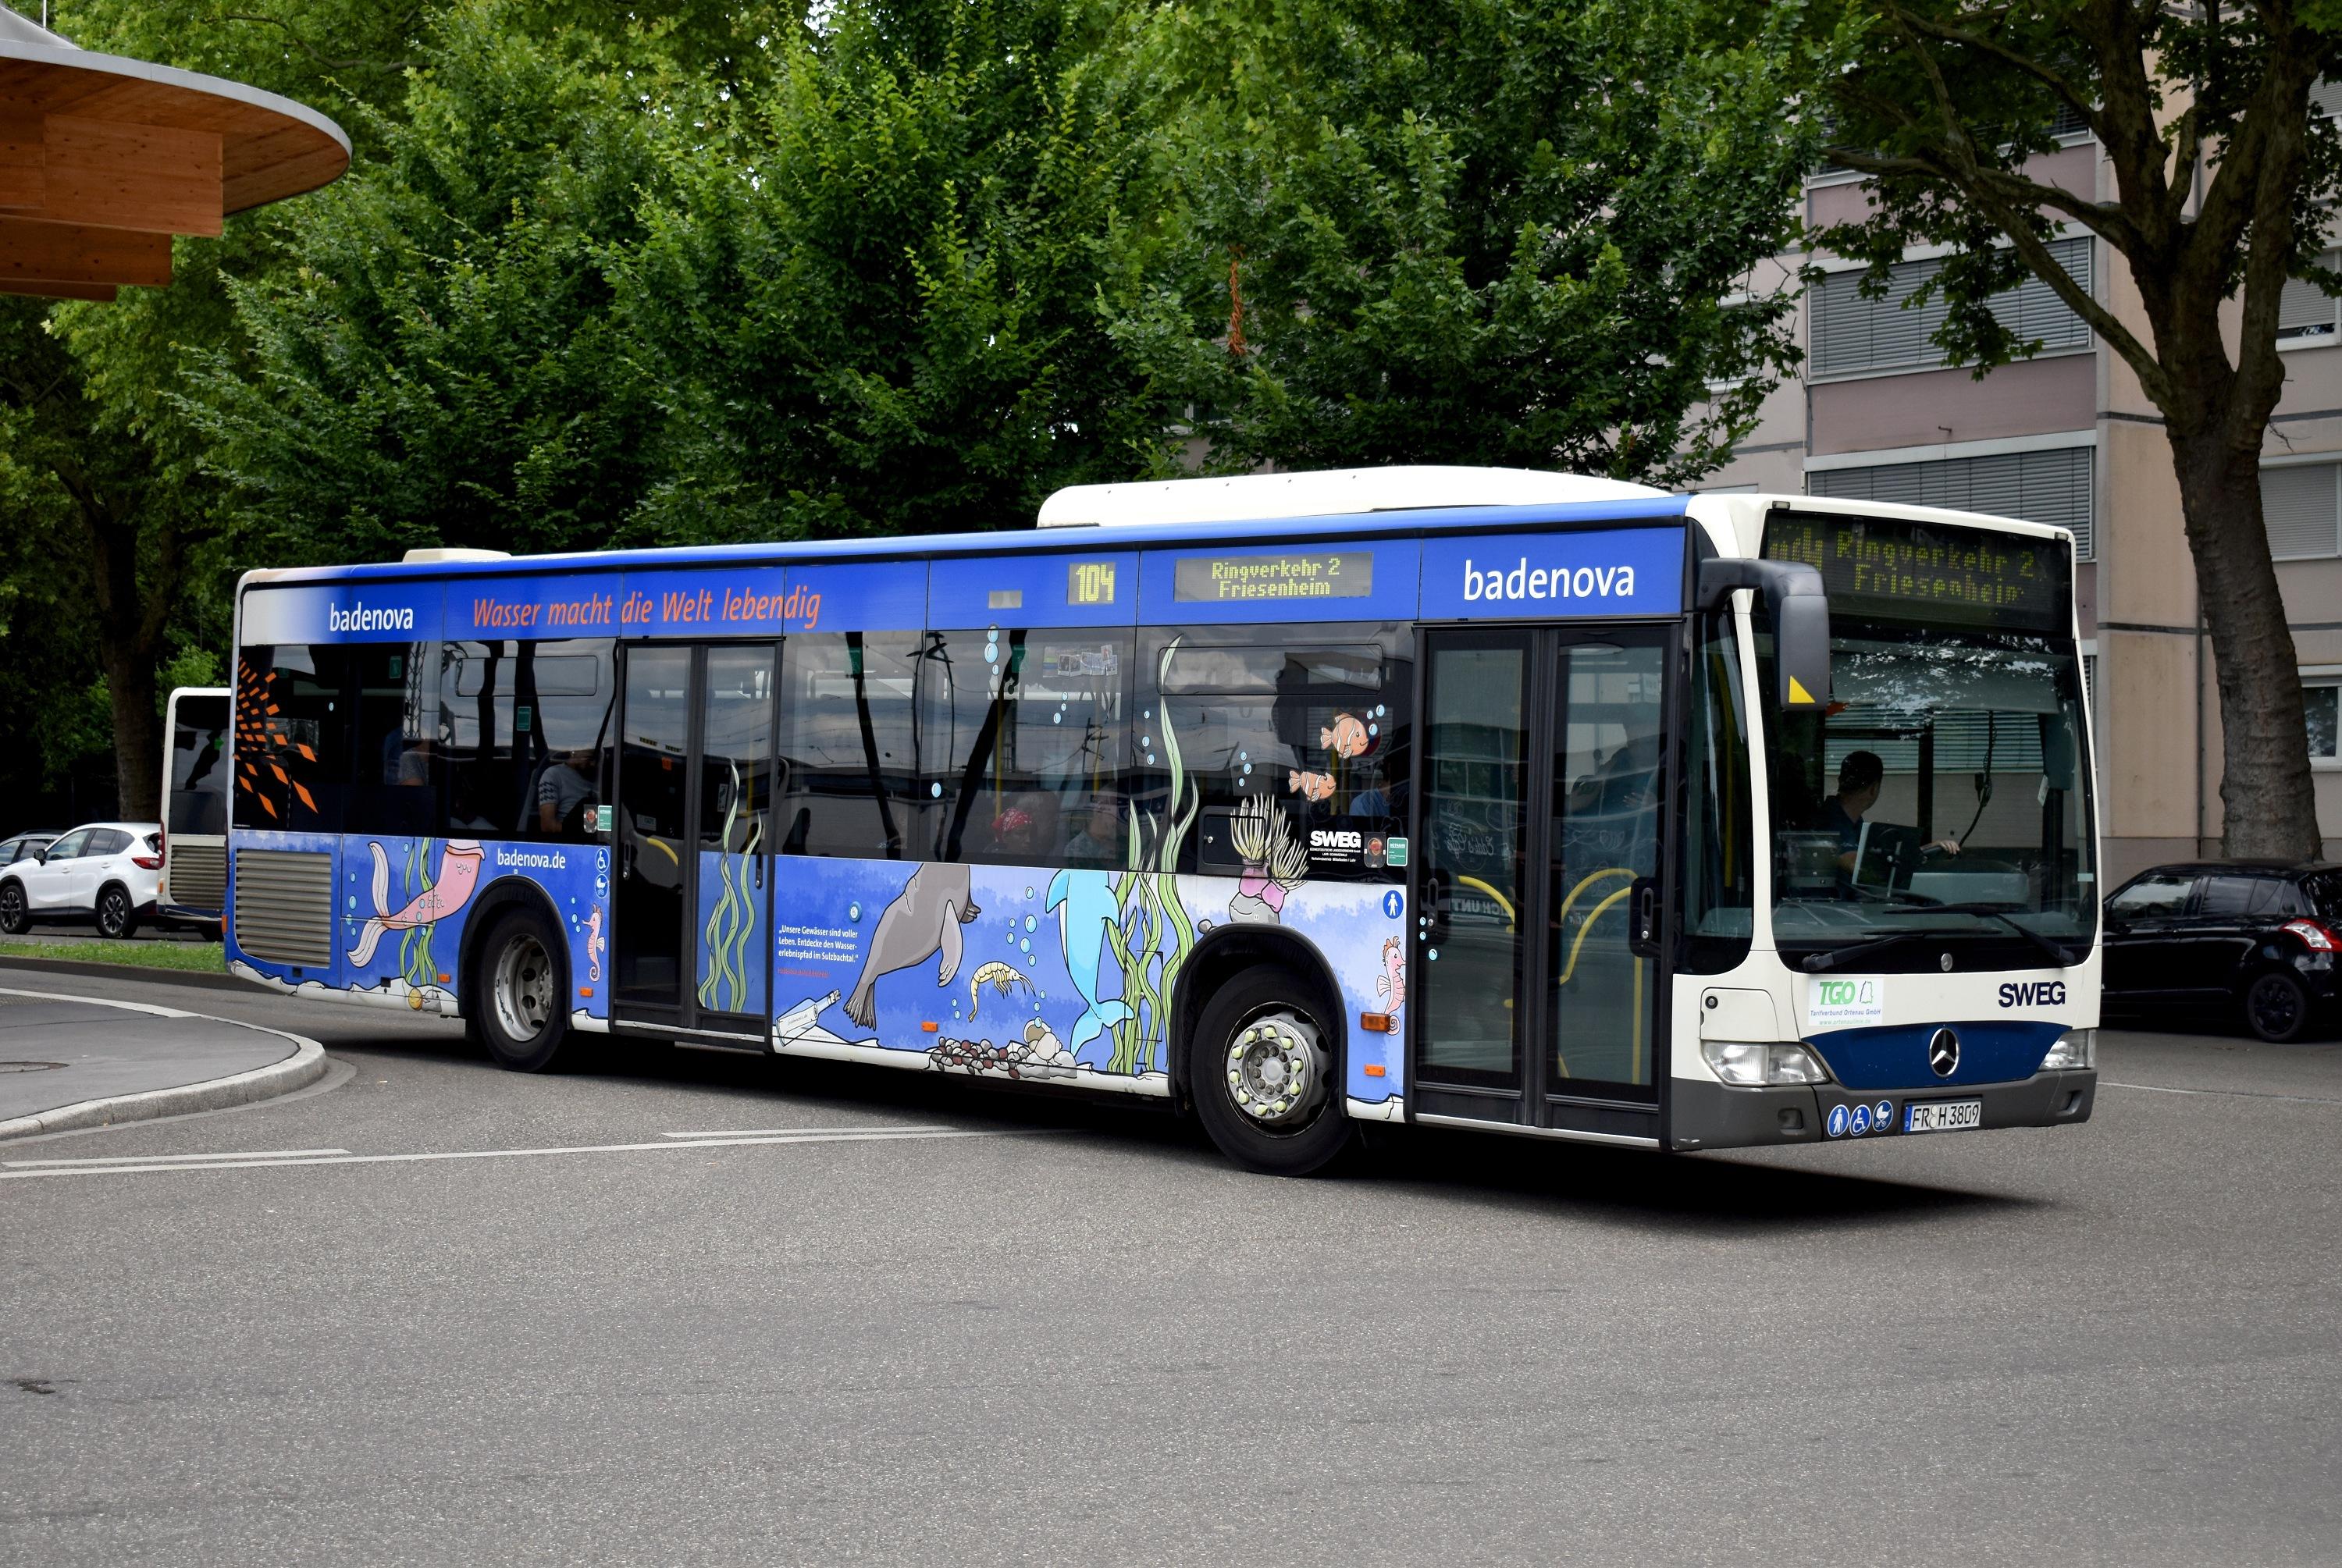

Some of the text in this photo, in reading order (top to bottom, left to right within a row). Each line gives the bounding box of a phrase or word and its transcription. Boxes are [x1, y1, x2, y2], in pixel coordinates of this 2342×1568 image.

[1837, 530, 2008, 574] Ringverkehr
[2020, 550, 2034, 578] 2
[1212, 557, 1340, 582] Ringverkehr 2
[1464, 557, 1635, 601] badenova
[1075, 564, 1115, 602] 104
[1219, 578, 1331, 598] Friesenheim
[329, 601, 414, 631] badenova
[474, 585, 822, 629] Wasser macht die Welt lebendig
[1309, 830, 1361, 848] SWEG
[497, 848, 566, 869] badenova.de
[802, 926, 828, 937] Gewässer
[829, 928, 842, 937] sind
[842, 929, 858, 938] voller
[778, 937, 857, 951] Leben. Entdecke den Wasser-
[778, 948, 813, 961] erlebnispfad
[1819, 981, 1856, 1005] TGO
[1999, 980, 2066, 1008] SWEG
[1810, 1008, 1842, 1017] Tarifverbund
[1912, 1108, 1930, 1128] FR
